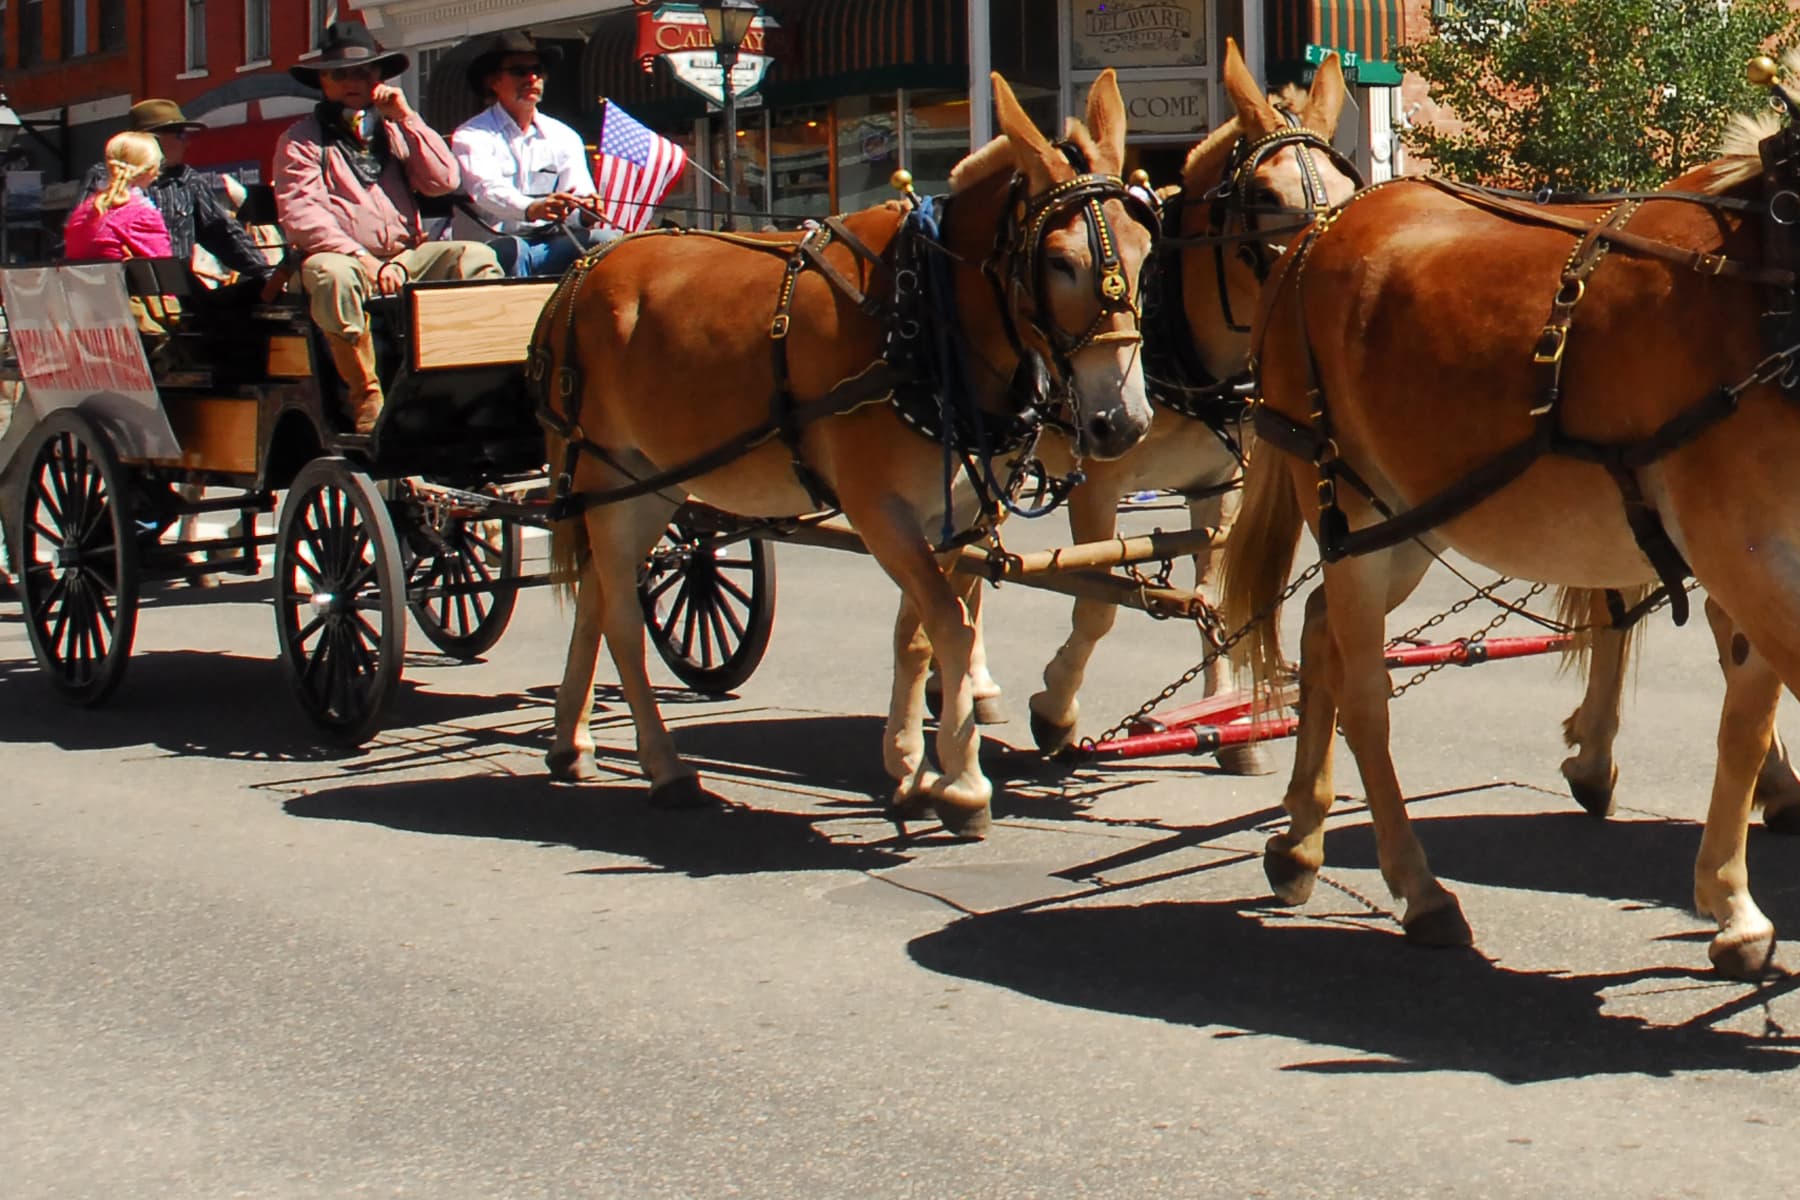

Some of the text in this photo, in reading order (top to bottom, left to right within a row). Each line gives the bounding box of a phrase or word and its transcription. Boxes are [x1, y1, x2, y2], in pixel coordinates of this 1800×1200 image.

[1089, 6, 1187, 35] DELAWARE
[1305, 44, 1313, 61] E
[1343, 52, 1357, 66] ST
[1129, 96, 1200, 119] COME
